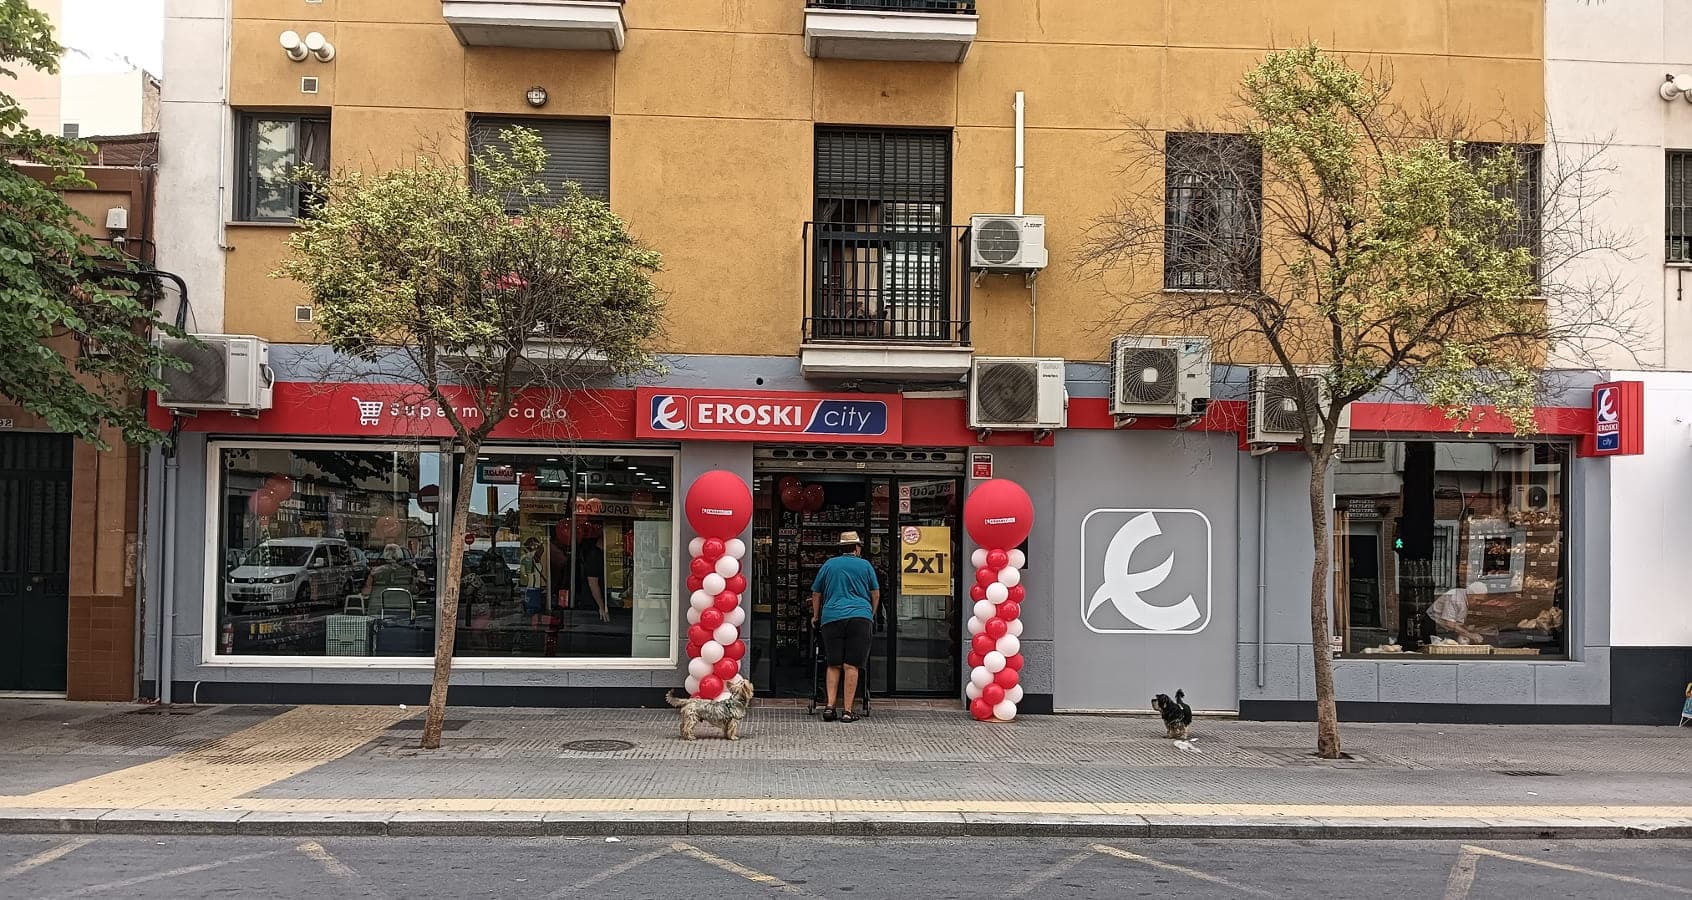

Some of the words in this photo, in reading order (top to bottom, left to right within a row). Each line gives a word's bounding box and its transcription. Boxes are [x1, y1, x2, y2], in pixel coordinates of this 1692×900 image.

[698, 404, 802, 426] EROSKI
[824, 406, 872, 432] city
[1598, 424, 1618, 432] EROSKI
